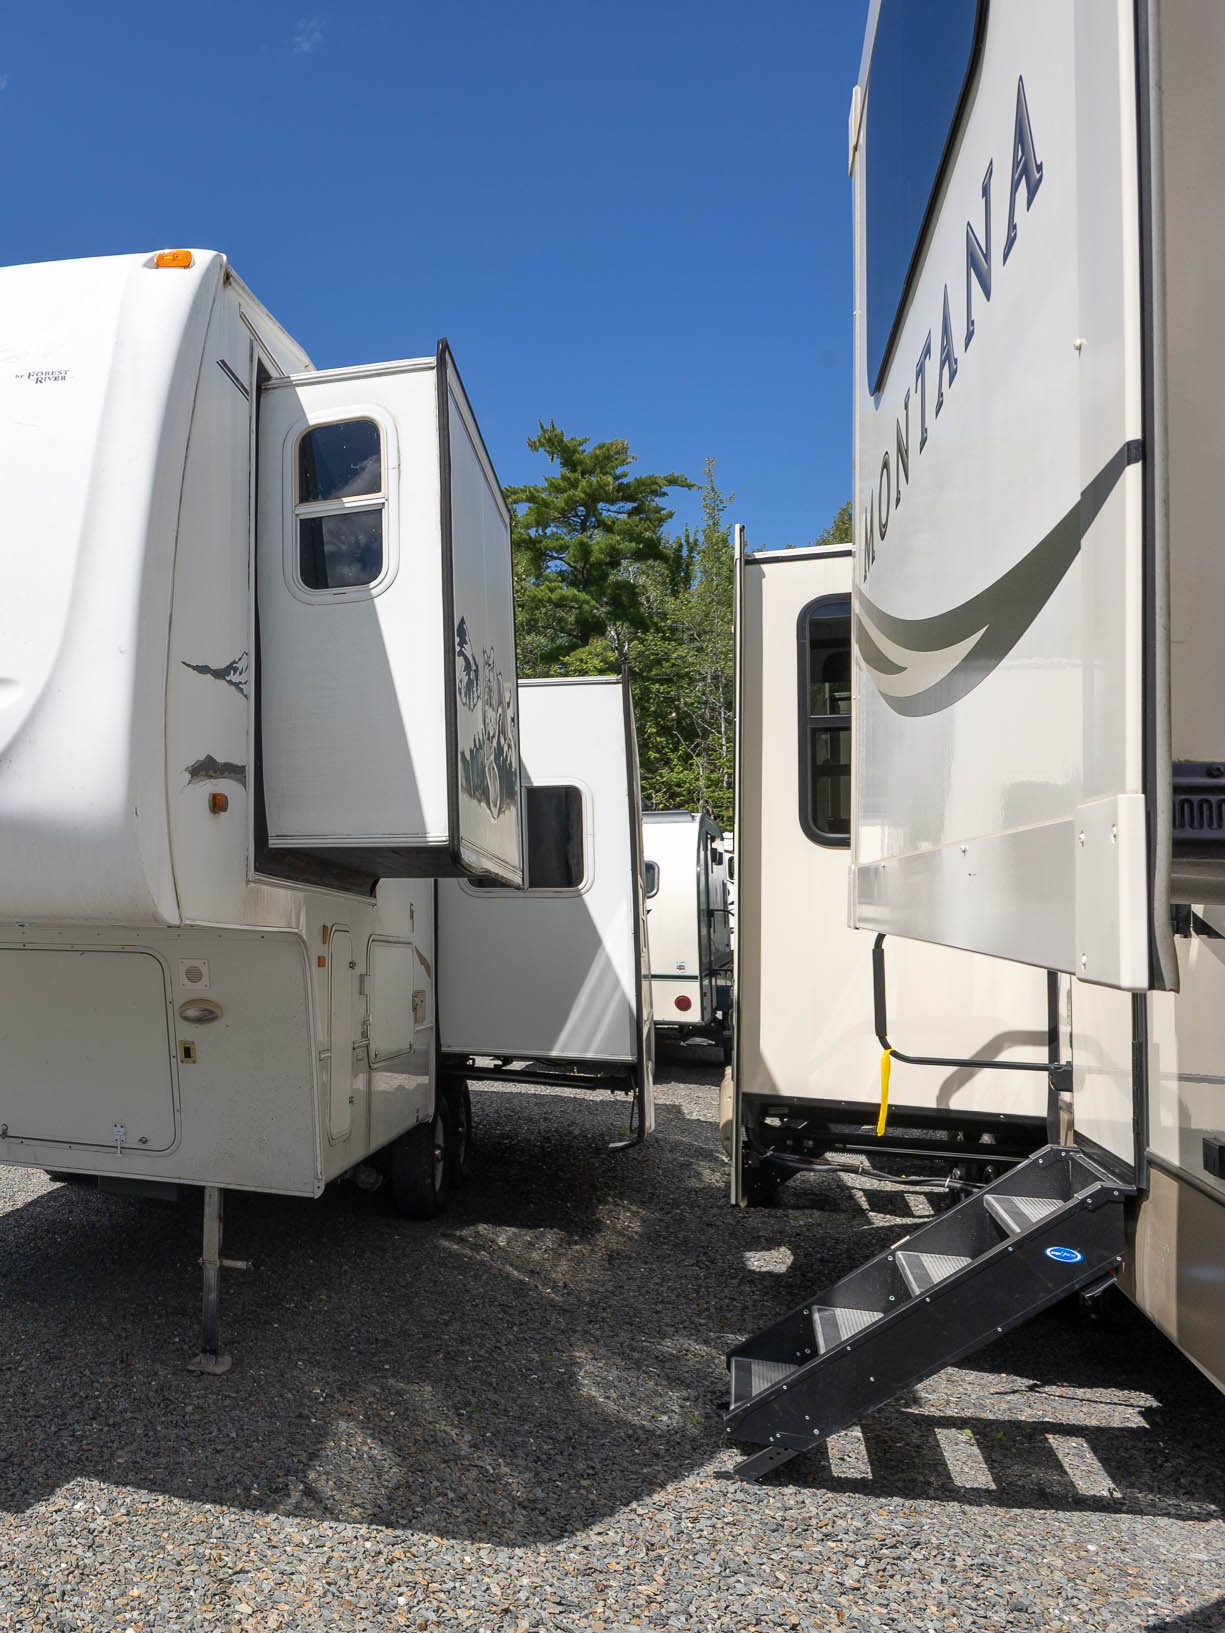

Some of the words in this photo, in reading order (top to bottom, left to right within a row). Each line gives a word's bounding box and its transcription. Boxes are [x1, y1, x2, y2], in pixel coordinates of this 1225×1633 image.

[862, 74, 1044, 584] MONTANA
[27, 369, 71, 379] FOREST
[35, 375, 67, 384] RIVER
